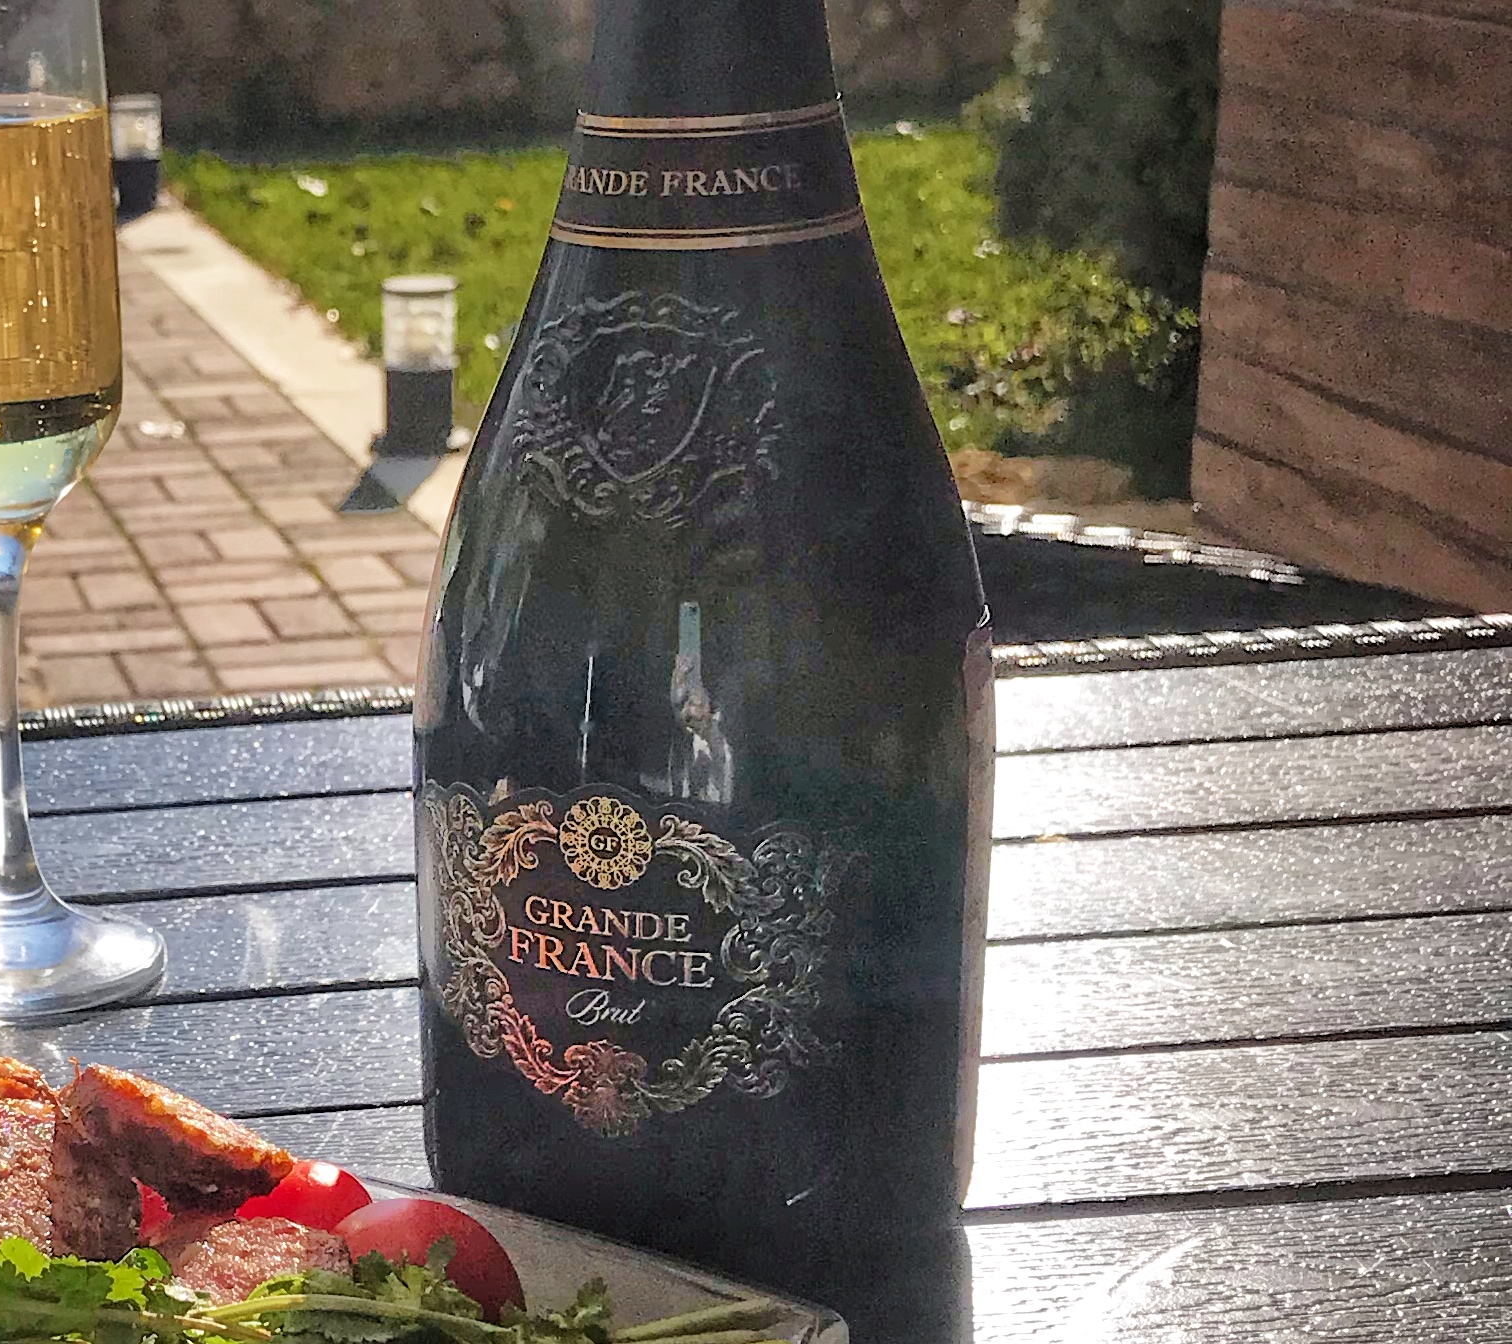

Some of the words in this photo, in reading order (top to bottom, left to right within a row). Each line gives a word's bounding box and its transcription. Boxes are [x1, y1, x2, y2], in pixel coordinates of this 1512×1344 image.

[565, 164, 649, 197] RANDE
[660, 163, 803, 197] FRANCE
[590, 834, 619, 853] GF
[524, 894, 691, 943] GRANDE
[507, 925, 714, 989] FRANCE
[565, 988, 646, 1026] Brut
